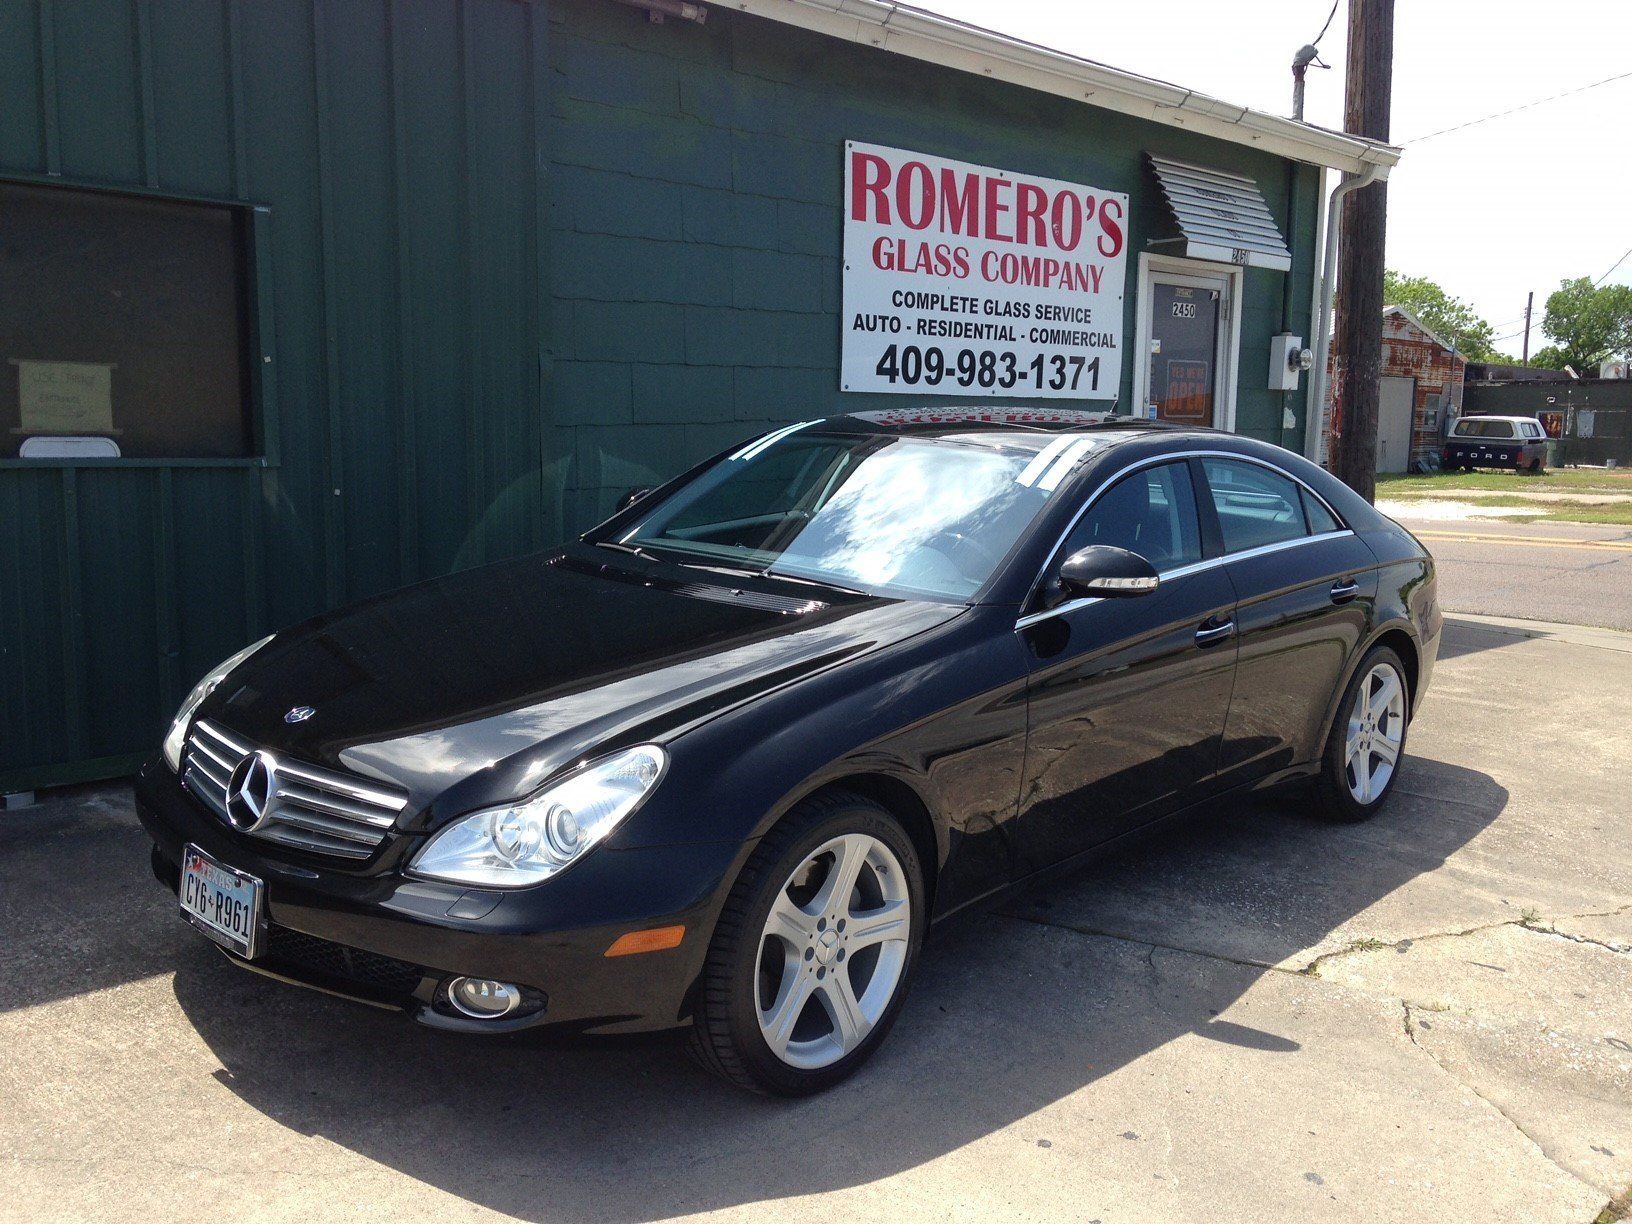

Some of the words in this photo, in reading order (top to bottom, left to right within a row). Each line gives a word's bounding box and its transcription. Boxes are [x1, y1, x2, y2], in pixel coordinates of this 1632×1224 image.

[852, 151, 1123, 258] ROMERO'S
[872, 236, 970, 279] GLASS
[981, 250, 1104, 294] COMPANY
[892, 289, 979, 314] COMPLETE
[983, 299, 1031, 319] GLASS
[1035, 304, 1092, 324] SERVICE
[1173, 303, 1195, 317] 2450
[852, 313, 901, 333] AUTO
[916, 318, 1017, 342] RESIDENTIAL
[1029, 328, 1117, 348] COMMERCIAL
[875, 344, 1100, 391] 409-983-1371
[1456, 452, 1508, 460] FORD
[201, 861, 233, 892] TEXAS
